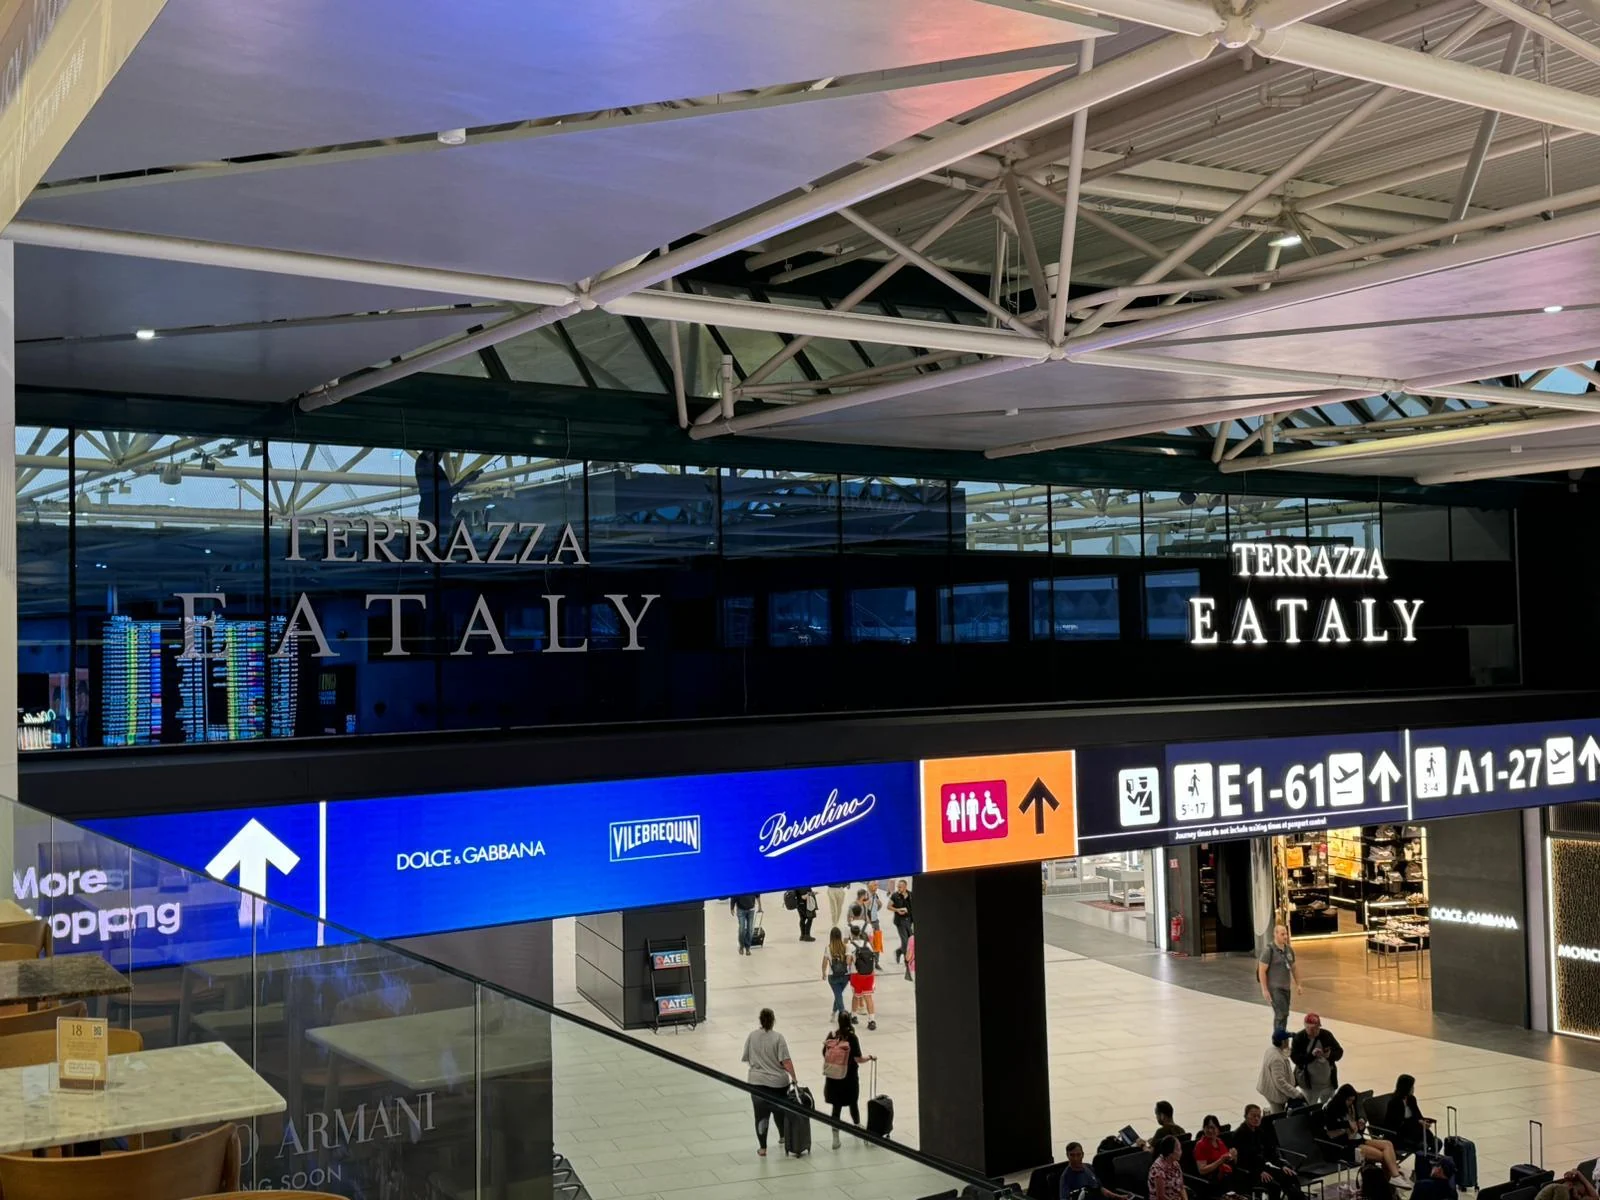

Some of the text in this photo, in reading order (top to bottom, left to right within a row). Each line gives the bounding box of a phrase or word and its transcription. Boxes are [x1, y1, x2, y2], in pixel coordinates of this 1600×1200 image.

[283, 515, 590, 565] TERRAZZA
[1232, 542, 1389, 580] TERRAZZA
[173, 592, 661, 658] EATALY
[1189, 597, 1424, 645] EATALY
[1218, 762, 1325, 817] E1-61
[1452, 748, 1543, 796] A1-27
[613, 819, 698, 858] VILEBREQUIN
[759, 788, 876, 857] Borsalino
[396, 840, 546, 870] DOLCE & GABBANA
[1431, 906, 1463, 923] DOLCE
[1466, 911, 1518, 930] GABBANA
[1558, 944, 1600, 963] MONC
[72, 1024, 83, 1037] 18
[275, 1092, 436, 1159] ARMANI
[281, 1165, 342, 1191] SOON
